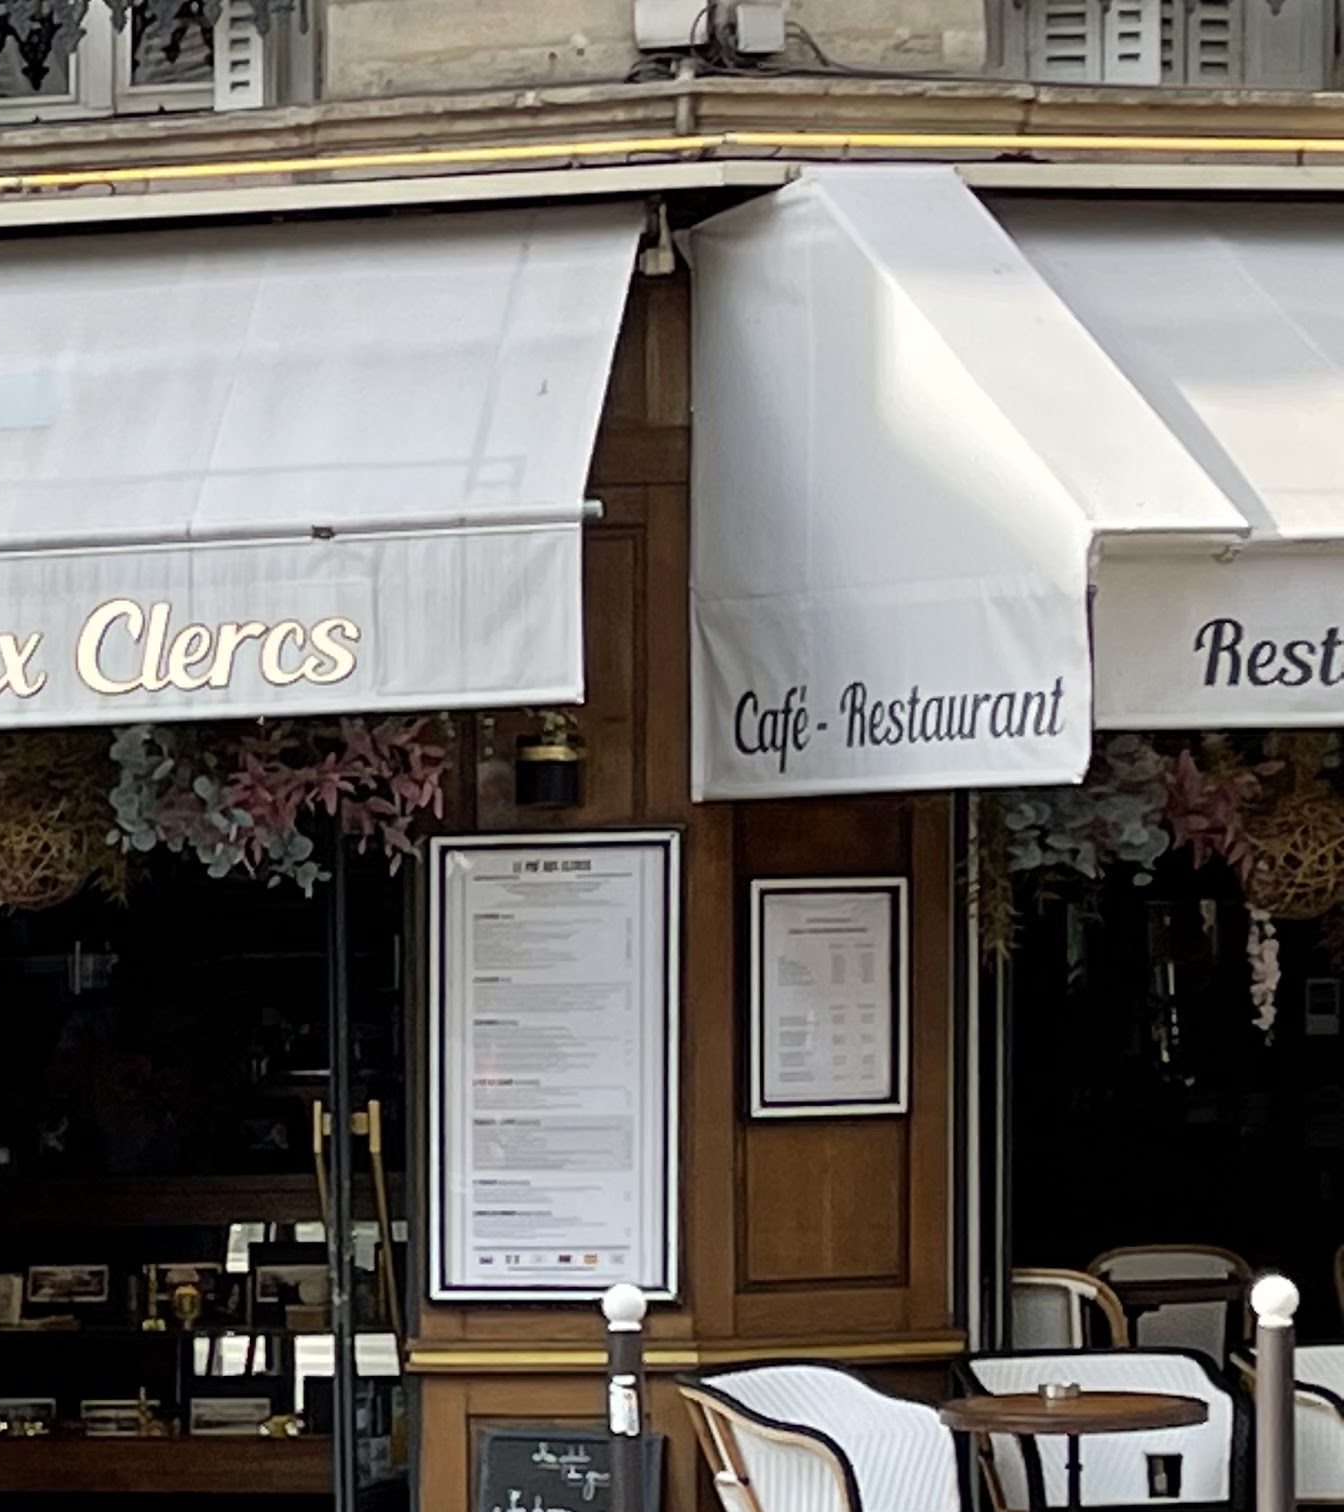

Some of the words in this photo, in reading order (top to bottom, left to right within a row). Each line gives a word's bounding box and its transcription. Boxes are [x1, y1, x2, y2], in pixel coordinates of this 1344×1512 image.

[75, 598, 361, 696] Clercs
[734, 685, 809, 774] Café
[840, 676, 1066, 748] Restaurant
